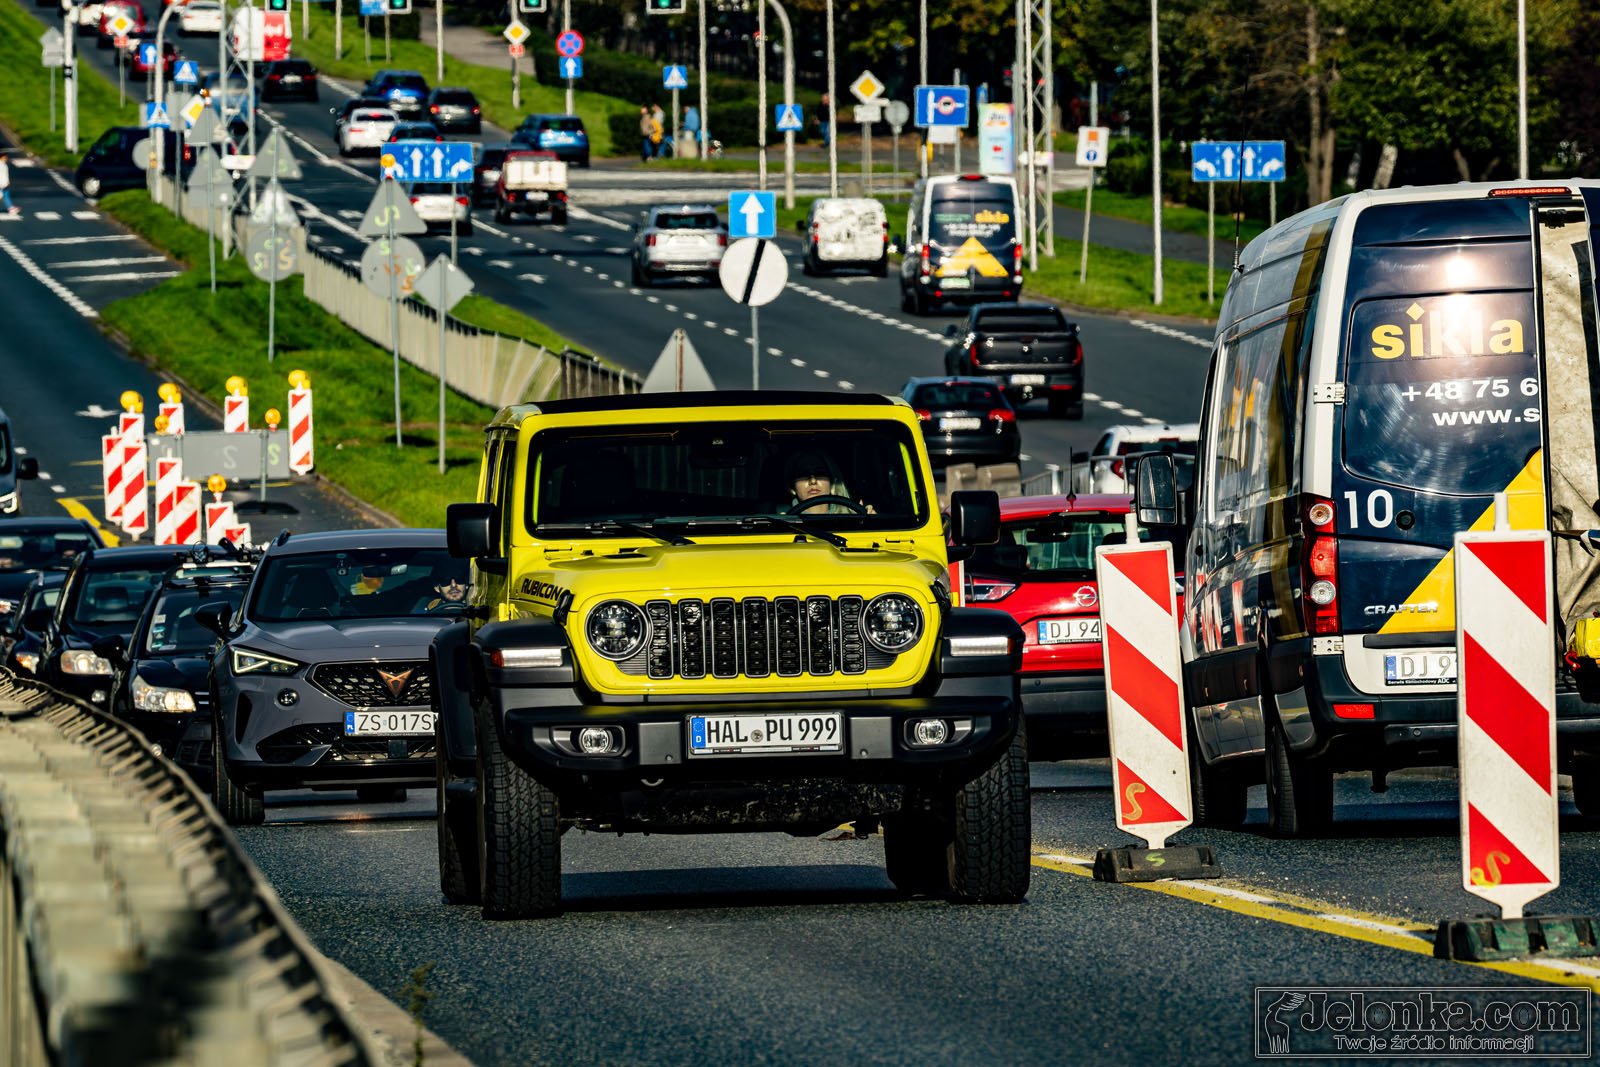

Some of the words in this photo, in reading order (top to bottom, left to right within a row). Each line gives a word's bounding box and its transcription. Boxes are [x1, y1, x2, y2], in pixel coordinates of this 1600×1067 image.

[1371, 302, 1524, 360] sikla
[1401, 381, 1463, 402] +48
[1472, 378, 1509, 398] 75
[1519, 377, 1539, 397] 6
[1343, 489, 1394, 529] 10
[521, 578, 564, 602] RUBICON
[1364, 601, 1439, 615] CRAFTER
[1050, 621, 1071, 639] DJ
[1400, 655, 1428, 678] DJ
[358, 714, 381, 731] ZS
[388, 713, 438, 731] 017S
[706, 720, 749, 744] HAL
[765, 718, 793, 742] PU
[798, 717, 837, 741] 999
